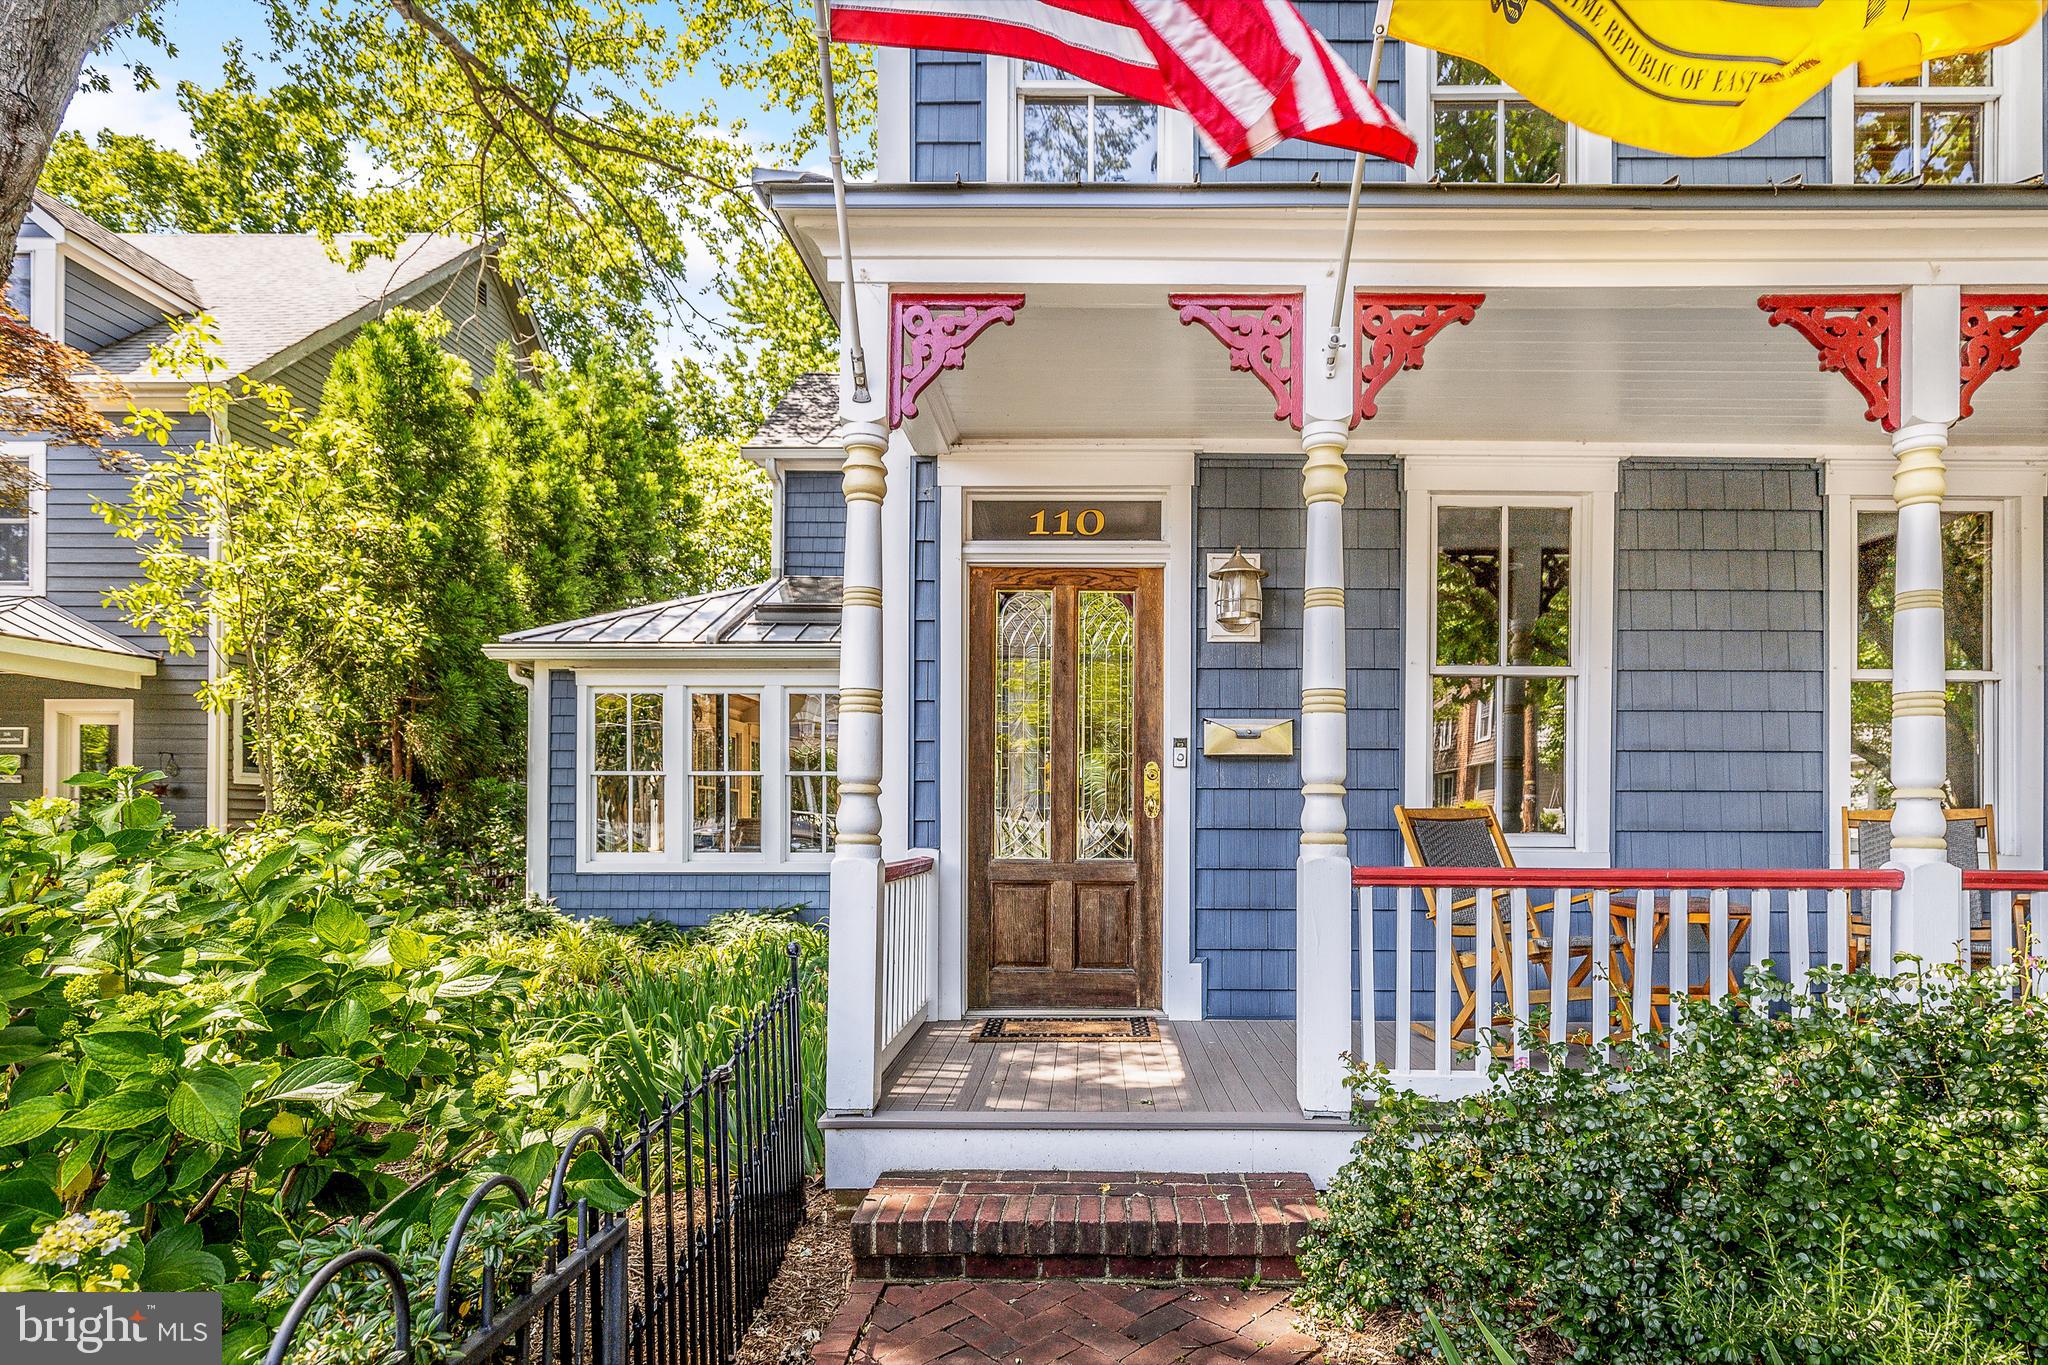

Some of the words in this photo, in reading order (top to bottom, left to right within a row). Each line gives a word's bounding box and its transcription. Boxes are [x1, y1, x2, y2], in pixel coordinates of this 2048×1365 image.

[1604, 20, 1678, 87] REPUBLIC
[1680, 66, 1708, 91] OF
[1028, 508, 1105, 536] 110
